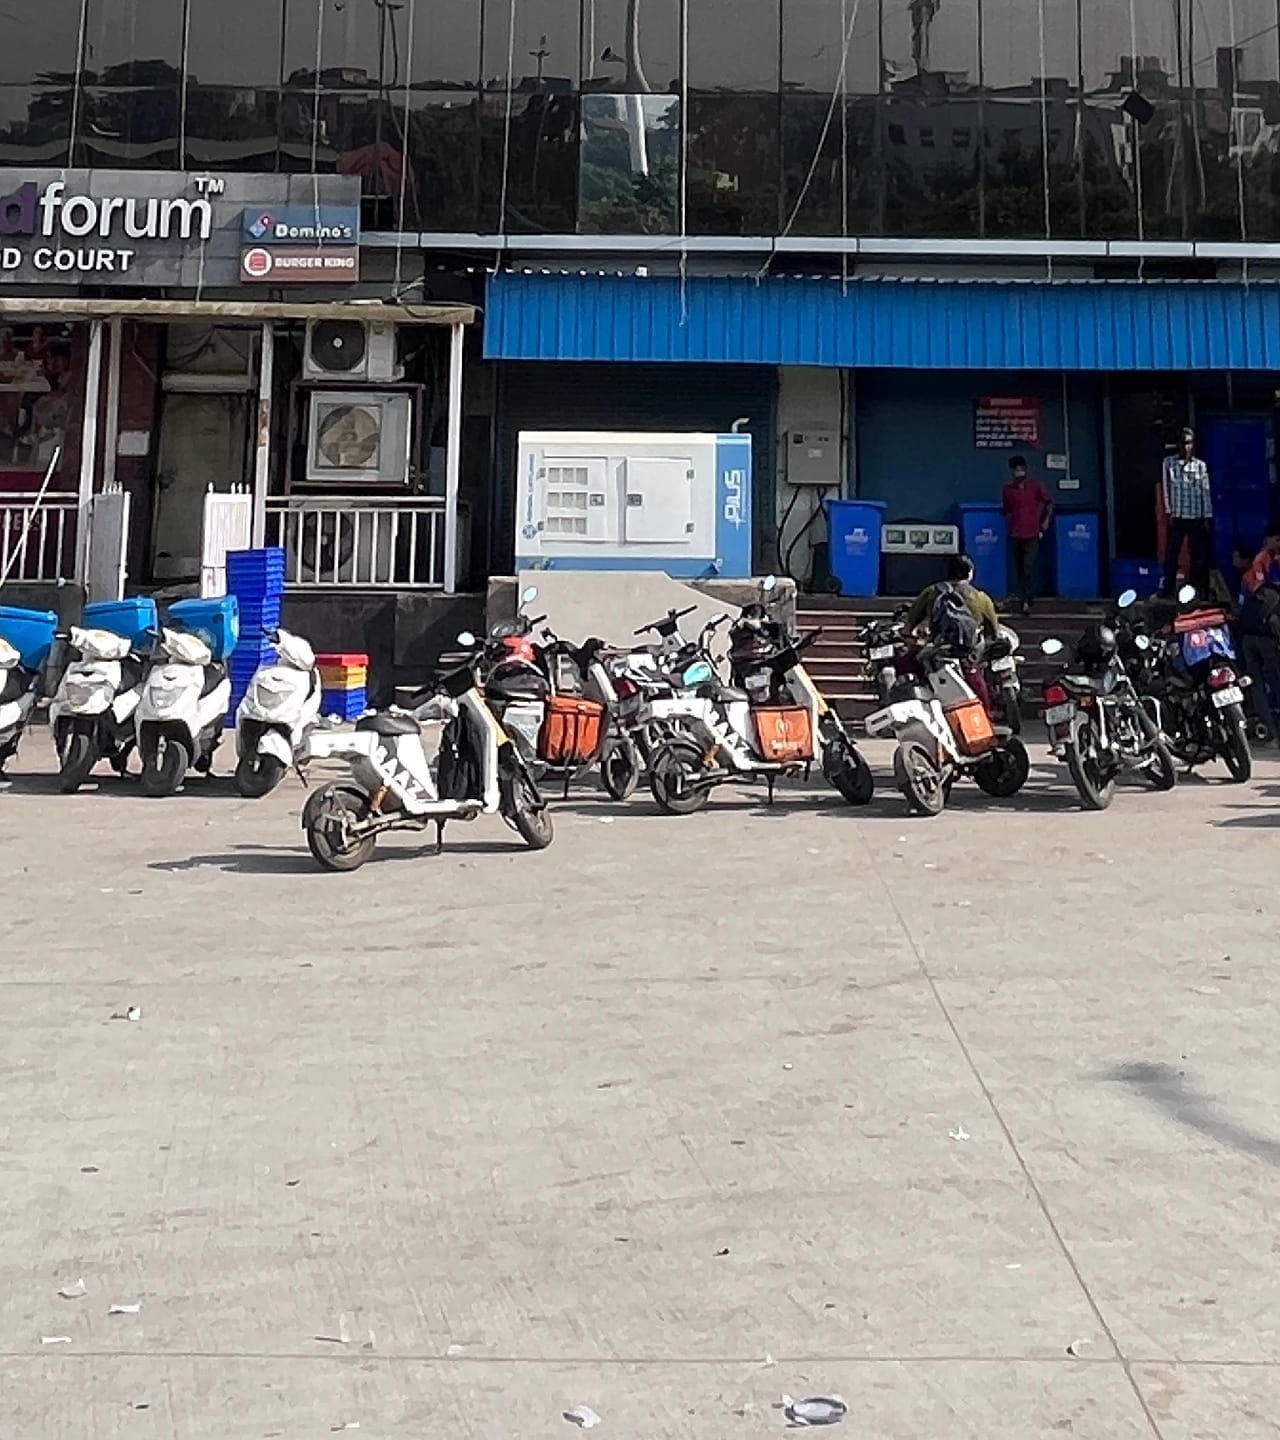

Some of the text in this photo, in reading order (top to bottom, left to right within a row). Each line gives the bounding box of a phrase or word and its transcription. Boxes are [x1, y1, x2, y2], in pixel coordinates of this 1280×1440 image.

[274, 223, 352, 238] Domino's
[33, 247, 135, 272] COURT
[274, 257, 322, 268] BURGER
